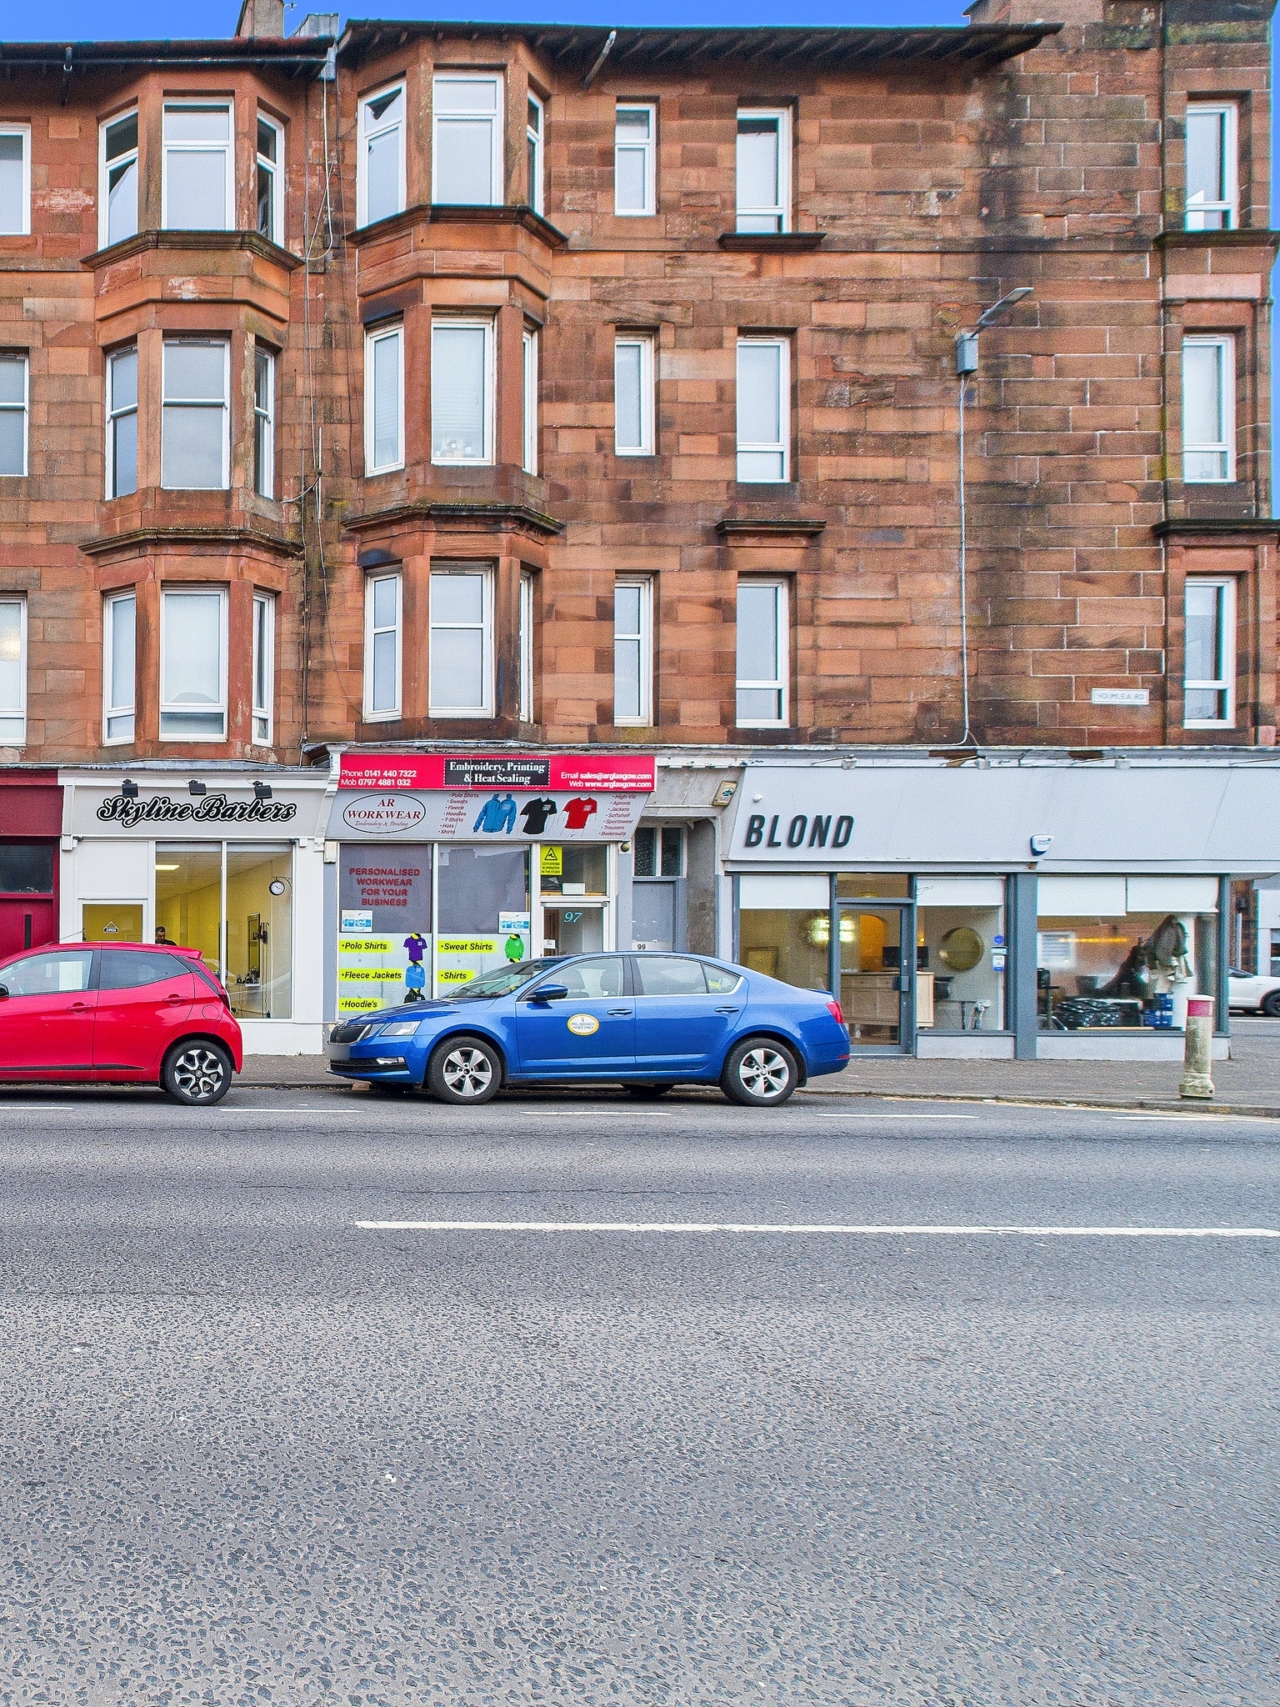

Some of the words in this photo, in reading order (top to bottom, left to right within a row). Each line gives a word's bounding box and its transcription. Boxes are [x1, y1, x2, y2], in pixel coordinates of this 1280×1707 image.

[449, 761, 505, 773] Embroidery,
[506, 761, 546, 773] Printing
[341, 769, 363, 777] Phone
[364, 769, 380, 777] 0141
[382, 769, 397, 777] 440
[398, 769, 417, 777] 7322
[579, 772, 652, 780] sales@arglasgow.com
[340, 778, 356, 786] Mob
[463, 773, 472, 783] &
[474, 773, 496, 783] Heat
[496, 773, 531, 785] Sealing
[377, 798, 395, 807] AR
[97, 795, 194, 828] Skyline
[192, 794, 297, 822] Barbers
[347, 810, 421, 819] WORKWEAR
[745, 814, 855, 848] BLOND
[349, 867, 421, 877] PERSONALISED
[356, 878, 413, 886] WORKWEAR
[361, 888, 380, 896] FOR
[381, 888, 408, 896] YOUR
[361, 898, 408, 906] BUSINESS
[563, 911, 583, 923] 97
[344, 942, 363, 950] Polo
[364, 942, 388, 950] Shirts
[443, 943, 468, 951] Sweat
[469, 943, 493, 951] Shirts
[344, 1000, 378, 1008] Hoodie's
